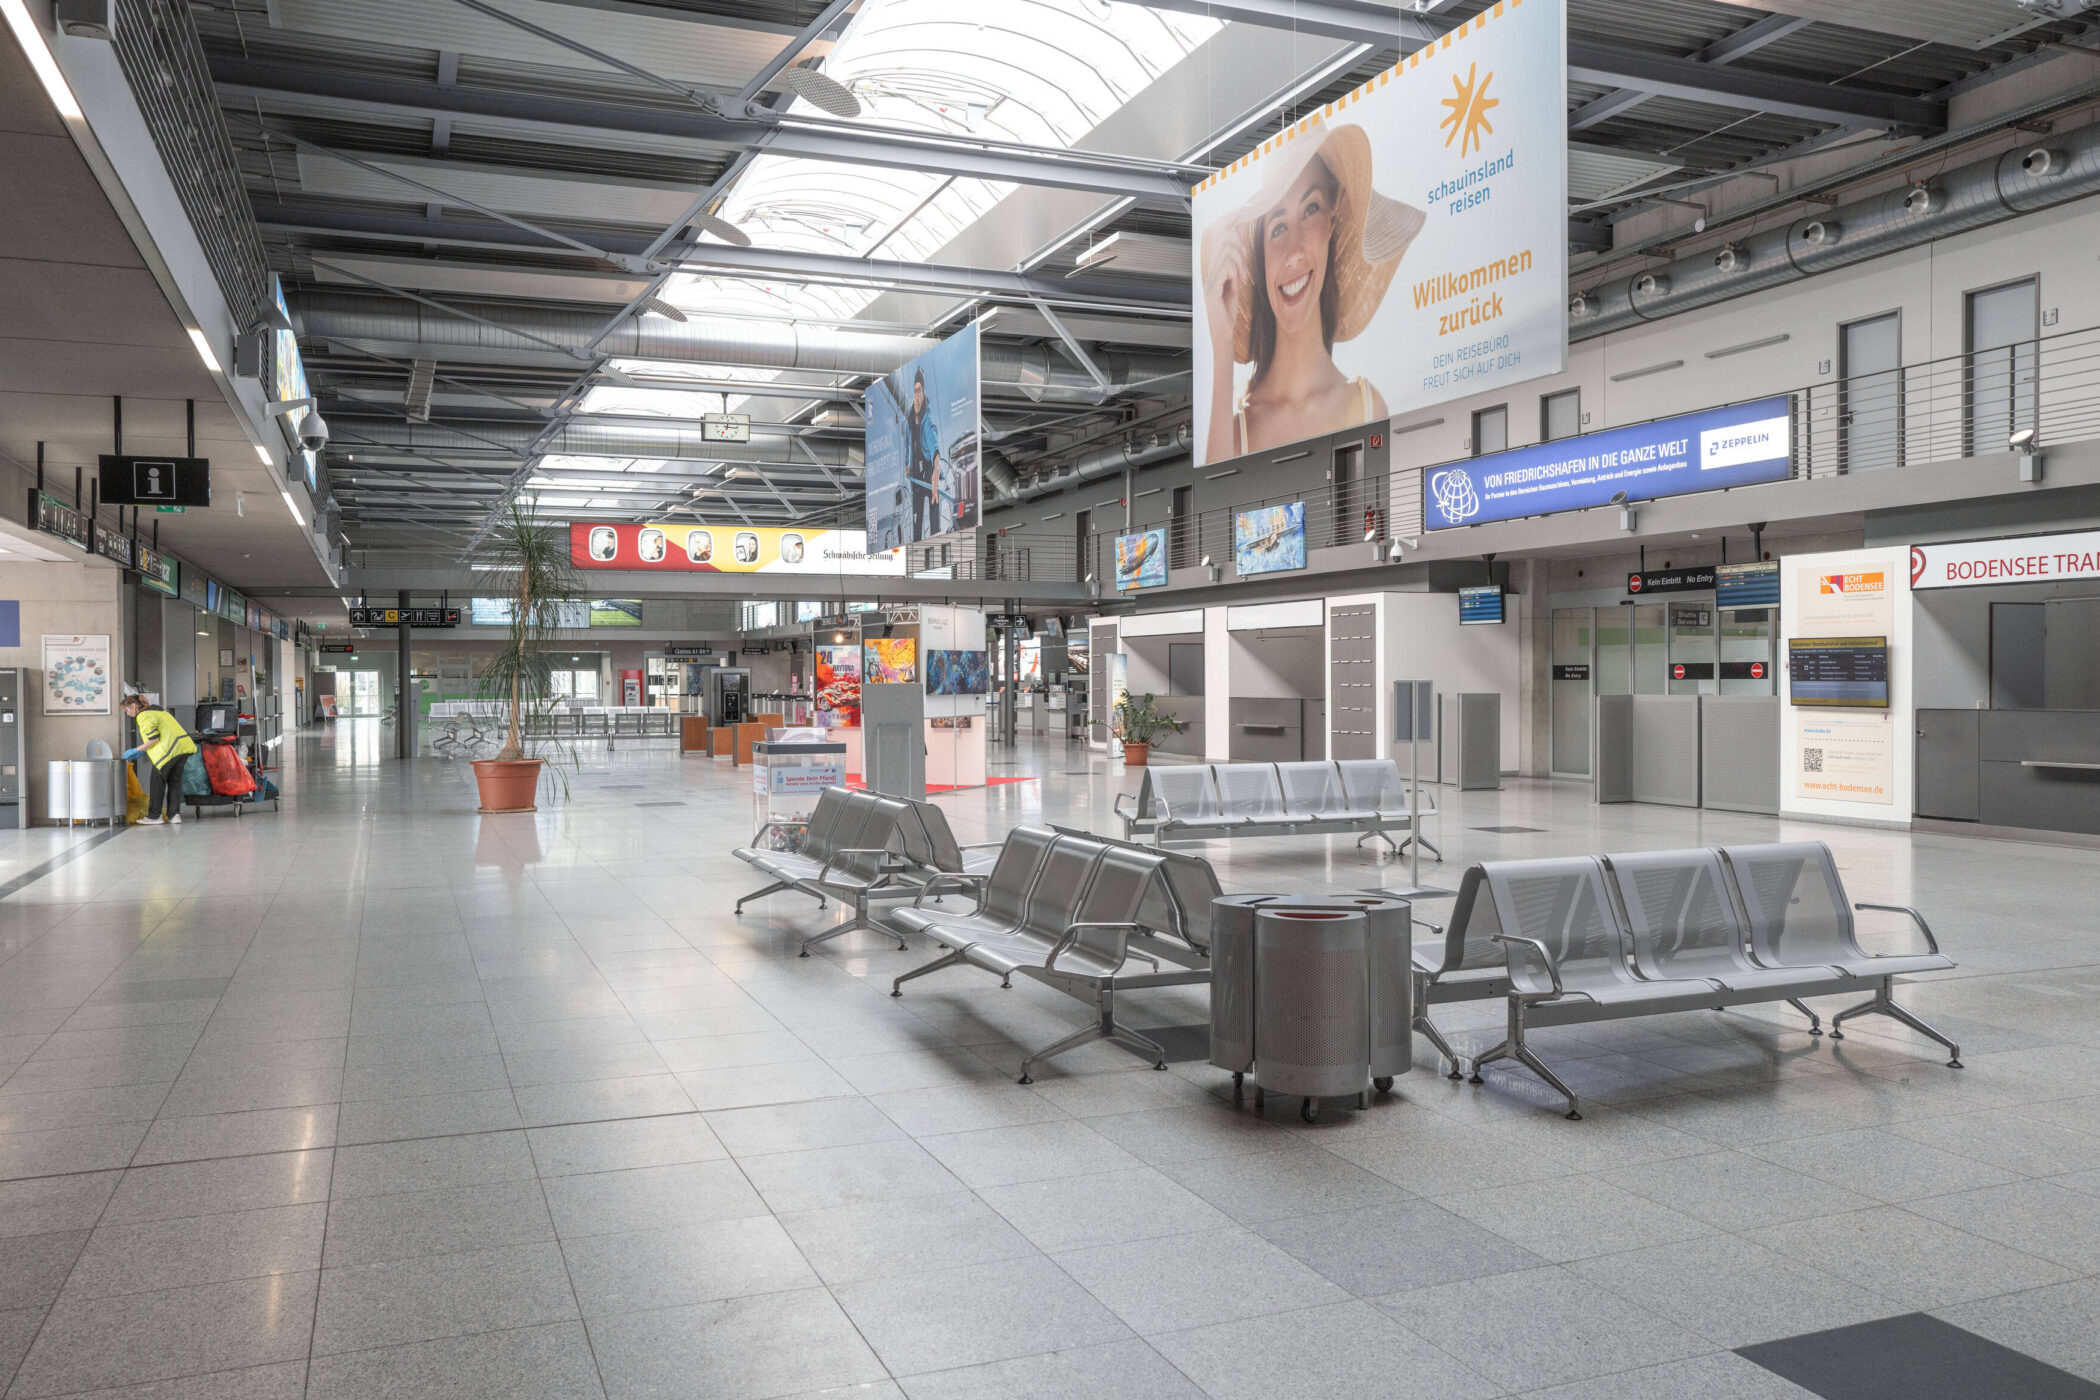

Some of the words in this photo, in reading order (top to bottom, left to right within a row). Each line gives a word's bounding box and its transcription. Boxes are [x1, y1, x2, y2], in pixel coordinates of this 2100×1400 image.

[1428, 148, 1514, 204] schauinsland
[1449, 186, 1490, 216] reisen
[1413, 249, 1532, 310] Willkommen
[1439, 293, 1503, 336] zurück
[1433, 352, 1454, 369] DEIN
[1457, 334, 1509, 364] REISEBÜRO
[1423, 368, 1450, 390] FREUT
[1453, 364, 1474, 383] SICH
[1476, 359, 1495, 378] AUF
[1498, 352, 1521, 371] DICH
[1722, 432, 1769, 449] ZEPPELIN
[1484, 474, 1502, 488] VON
[1504, 458, 1586, 485] FRIEDRICHSHAFEN
[1588, 456, 1599, 470] IN
[1602, 452, 1618, 469] DIE
[1620, 445, 1656, 464] GANZE
[1658, 439, 1688, 457] WELT
[1662, 576, 1682, 585] Eintritt
[1687, 576, 1696, 584] No
[1697, 574, 1714, 584] Entry
[1844, 576, 1864, 584] ECHT
[1947, 556, 2048, 580] BODENSEE
[1844, 582, 1883, 592] BODENSEE
[1070, 616, 1075, 628] 2
[820, 651, 833, 664] 24
[1804, 782, 1884, 794] www.echt-bodensee.de
